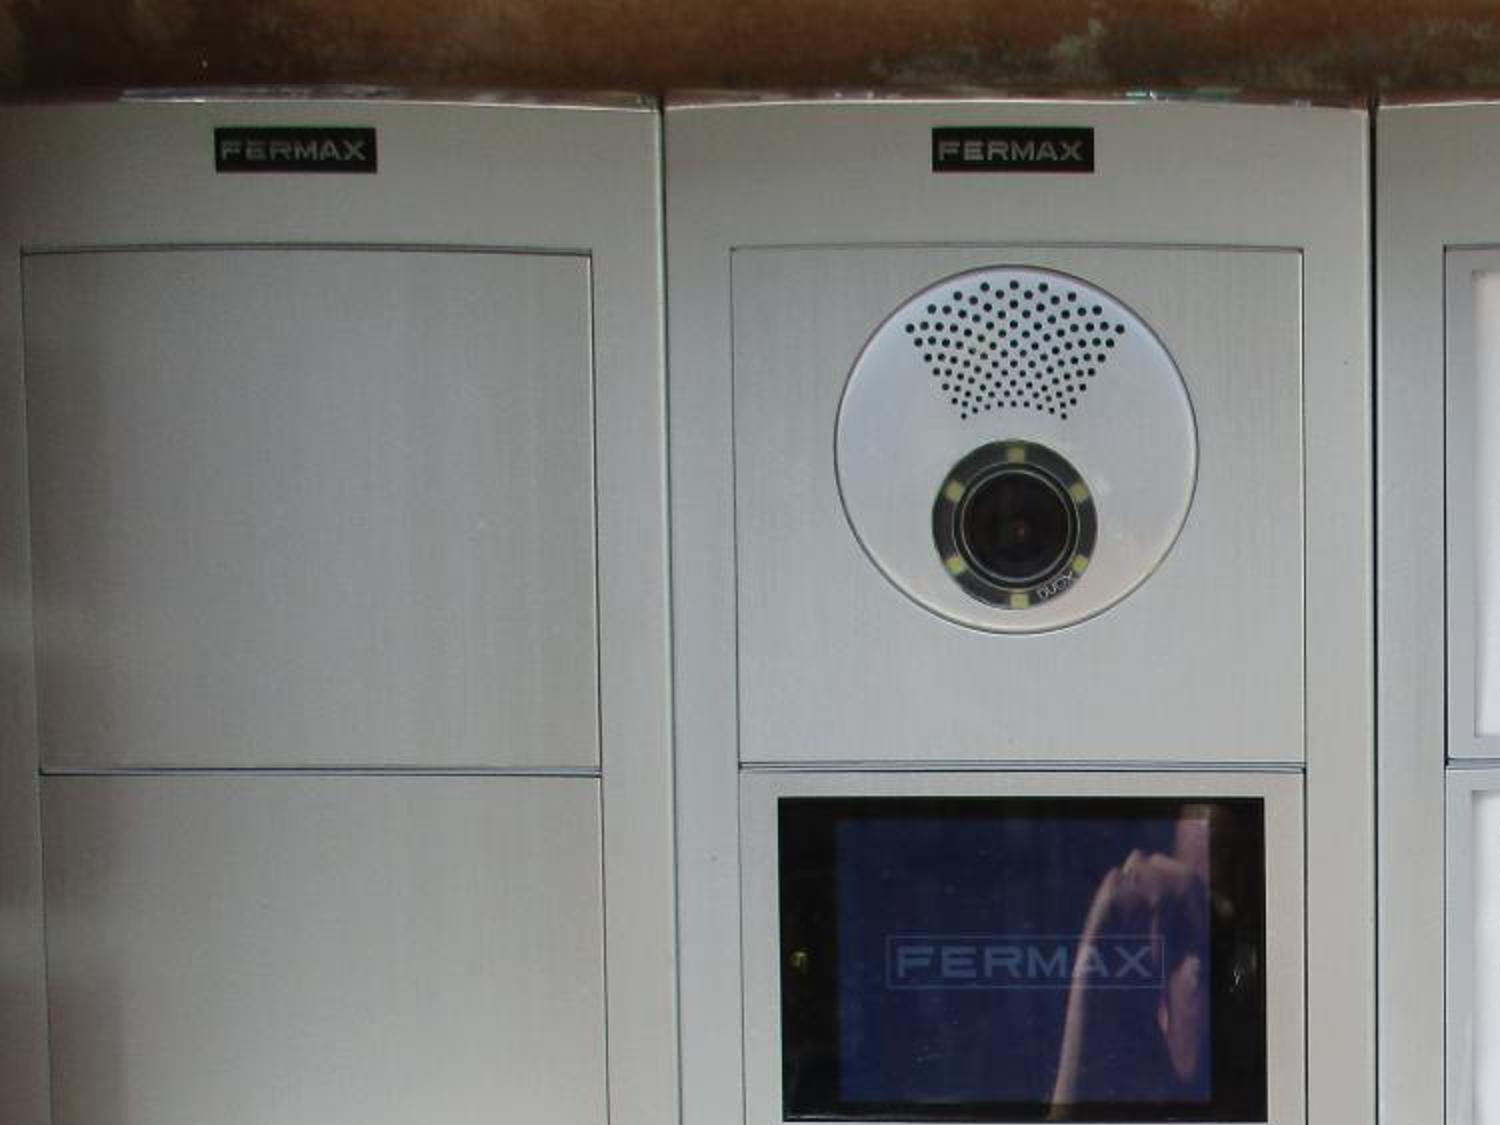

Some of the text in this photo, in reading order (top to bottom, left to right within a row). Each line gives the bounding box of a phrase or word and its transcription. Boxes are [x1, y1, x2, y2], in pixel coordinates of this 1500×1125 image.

[220, 140, 366, 162] FERMAX
[937, 140, 1083, 161] FERMAX
[895, 945, 1154, 979] FERMAX
